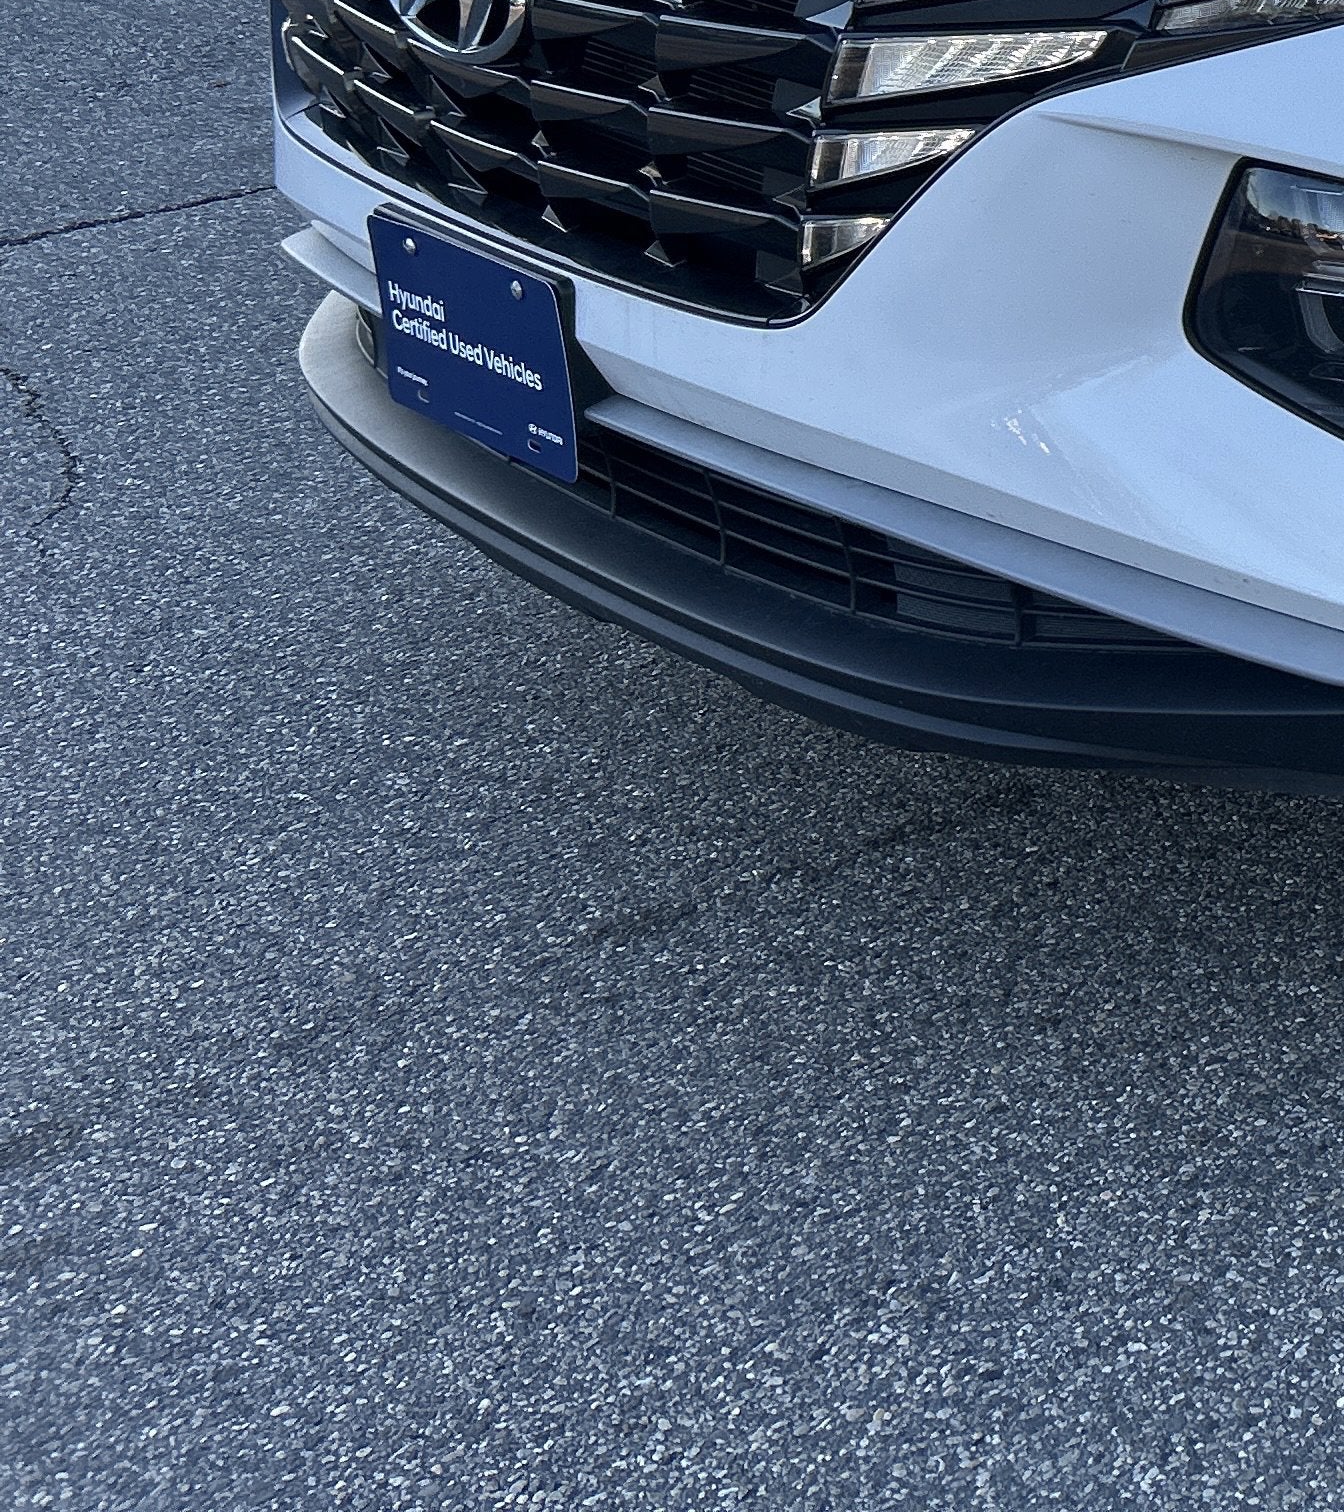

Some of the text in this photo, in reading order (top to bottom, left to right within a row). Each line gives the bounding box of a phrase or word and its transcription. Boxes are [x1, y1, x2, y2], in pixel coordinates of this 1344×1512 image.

[388, 280, 446, 322] Hyundai
[392, 309, 543, 391] Certified Used Vehicles
